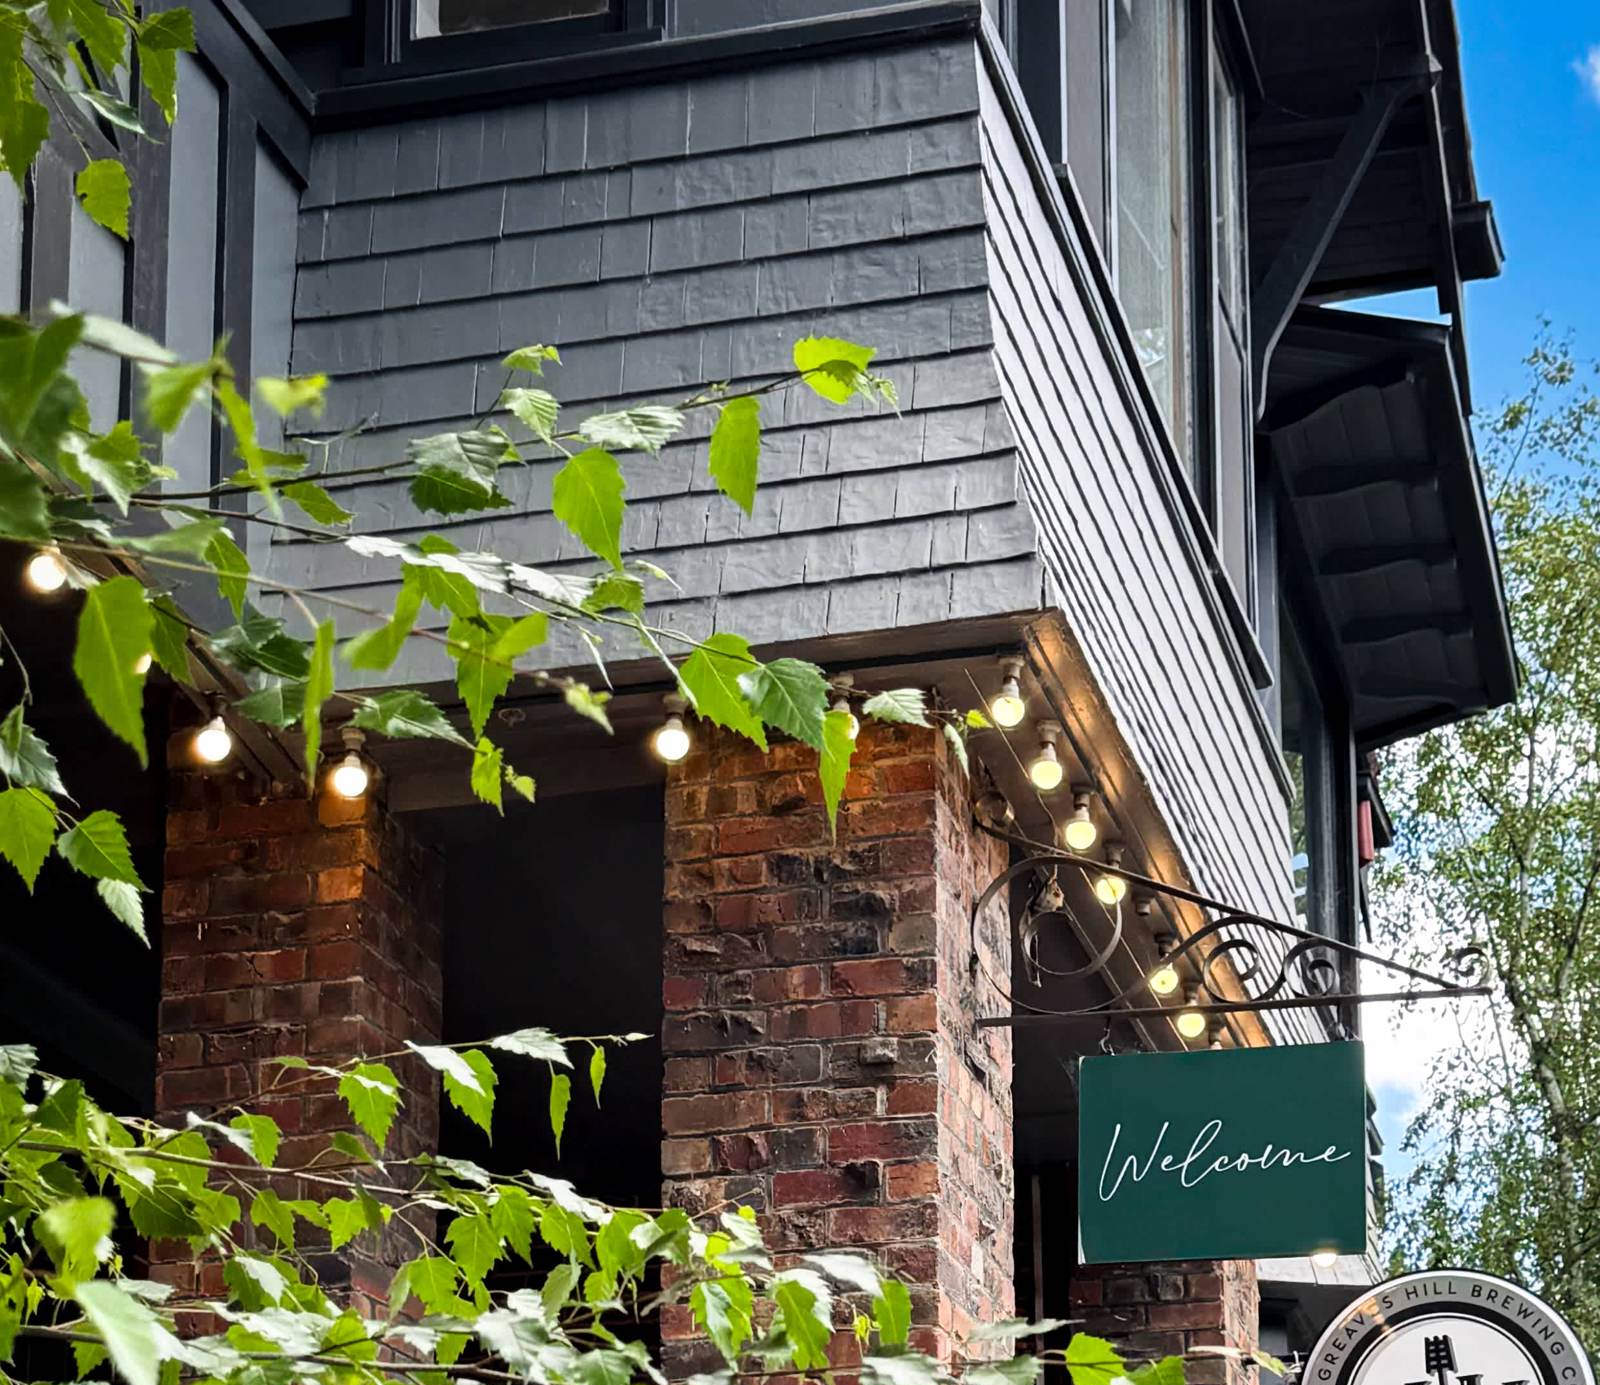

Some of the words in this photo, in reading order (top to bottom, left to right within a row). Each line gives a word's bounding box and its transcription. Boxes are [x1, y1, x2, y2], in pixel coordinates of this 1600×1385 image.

[1098, 1119, 1352, 1202] Welcome
[1404, 1281, 1458, 1301] HILL
[1470, 1283, 1566, 1357] BREWING
